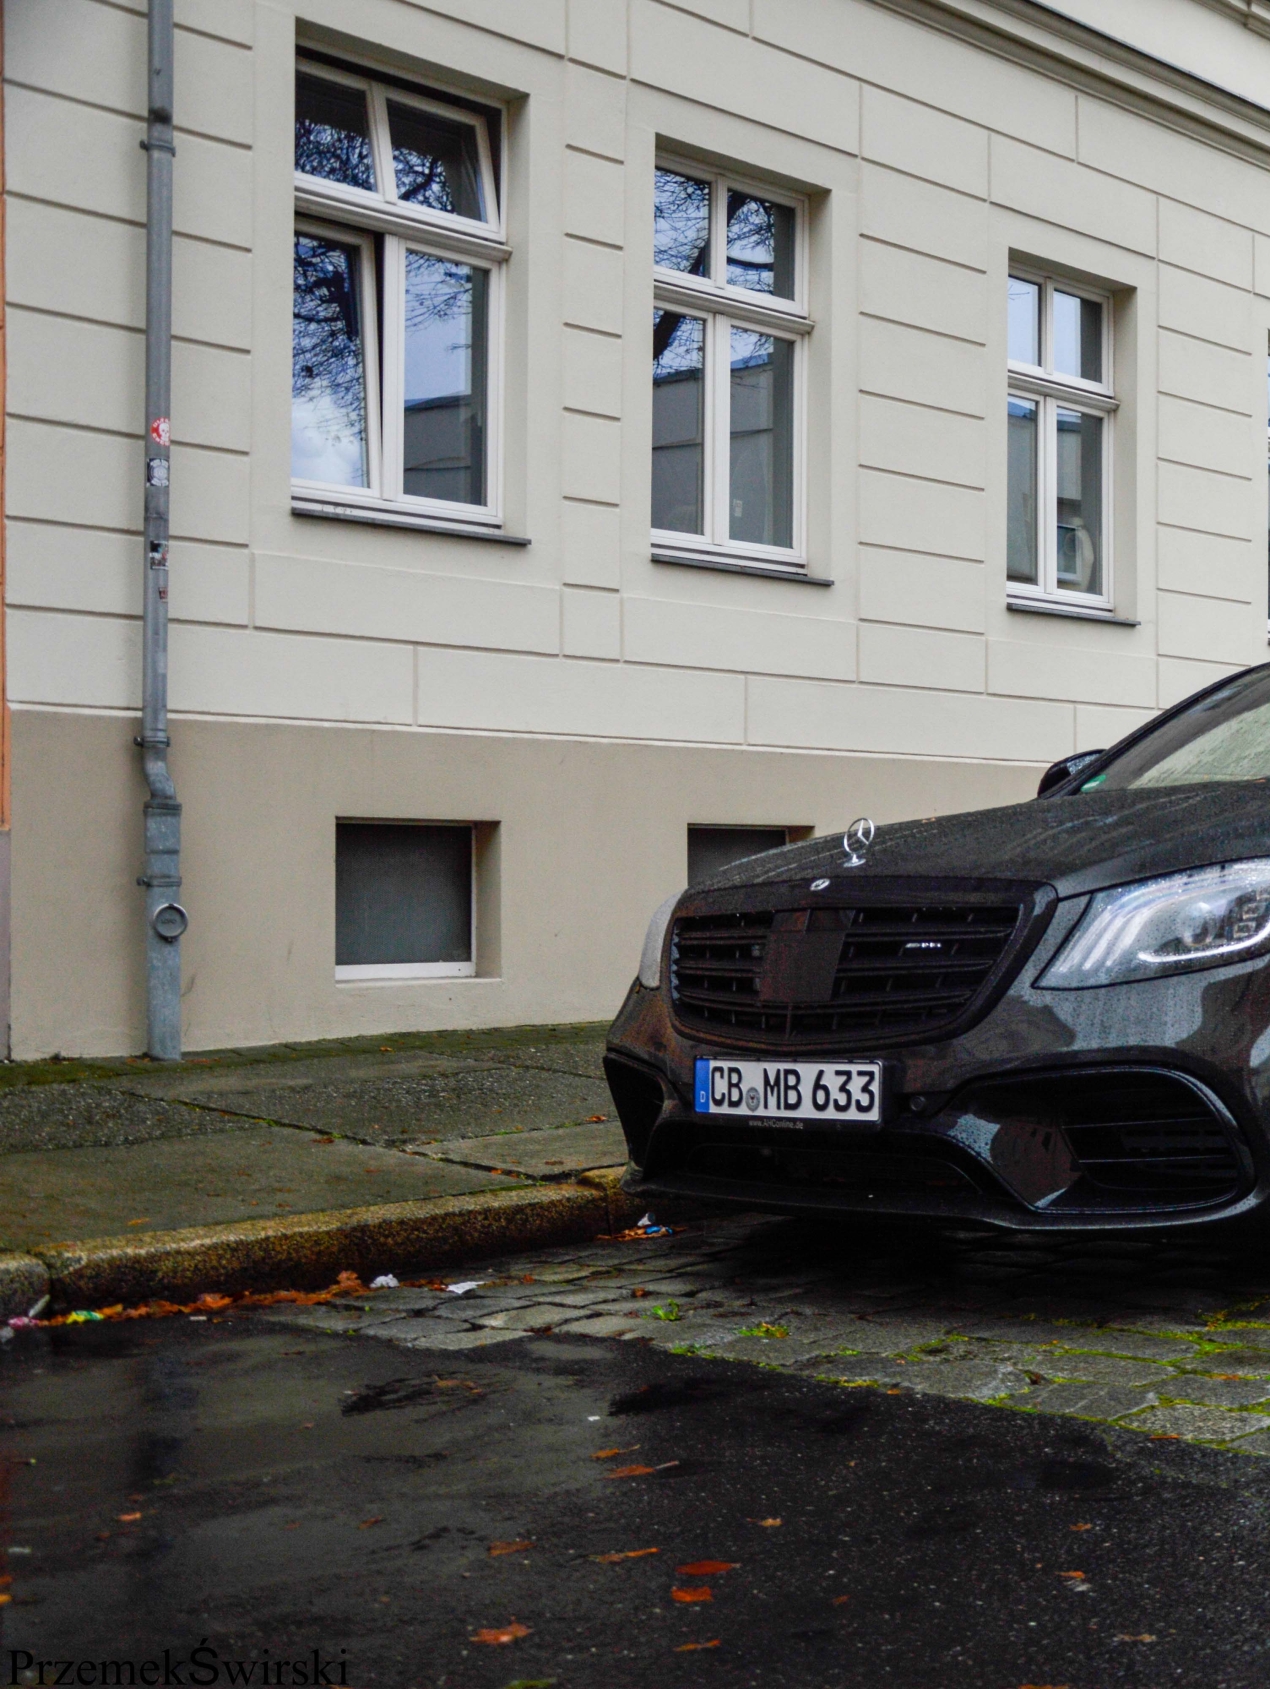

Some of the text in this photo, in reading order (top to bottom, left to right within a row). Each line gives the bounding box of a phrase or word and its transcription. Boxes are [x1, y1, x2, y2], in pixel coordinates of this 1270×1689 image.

[700, 1066, 876, 1113] D CB MB 633
